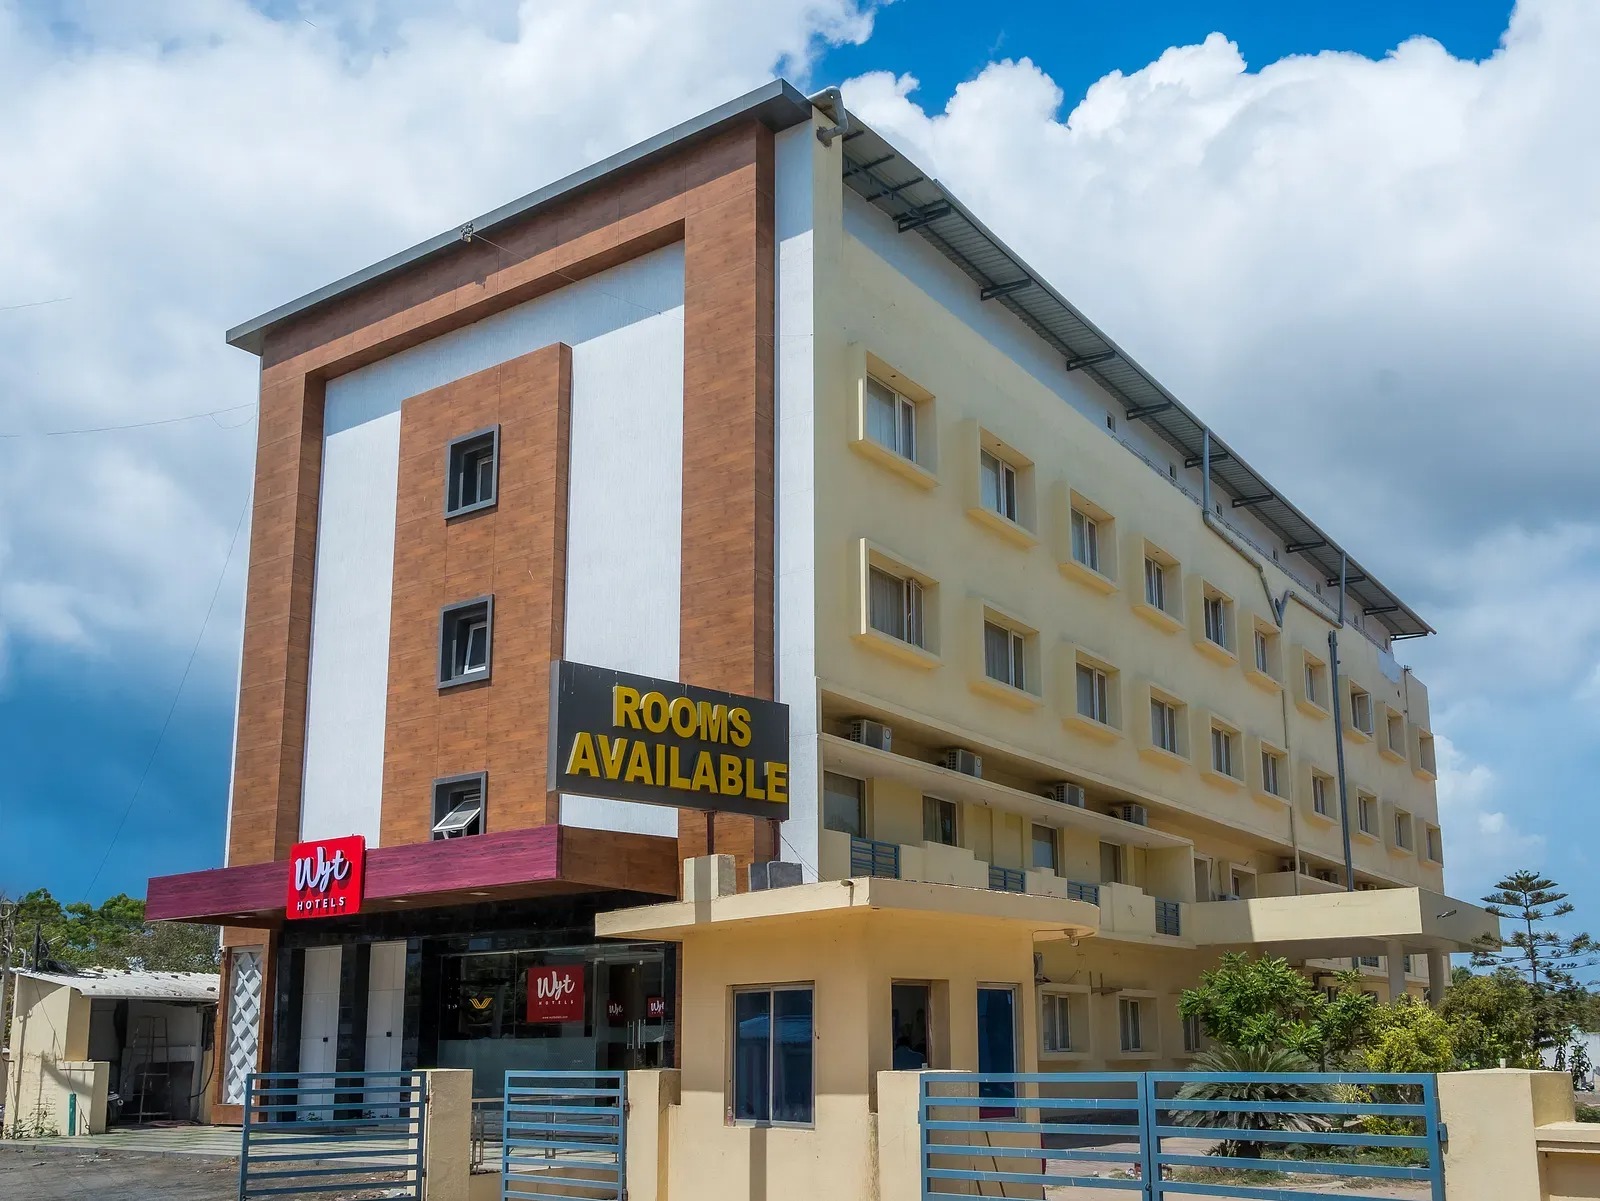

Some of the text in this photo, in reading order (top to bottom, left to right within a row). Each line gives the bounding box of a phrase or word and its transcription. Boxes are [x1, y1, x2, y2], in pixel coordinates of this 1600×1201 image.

[612, 685, 752, 748] ROOMS
[565, 732, 787, 803] AVAILABLE
[295, 846, 349, 892] Wyt
[297, 896, 344, 910] HOTELS
[537, 971, 575, 1000] Wyt
